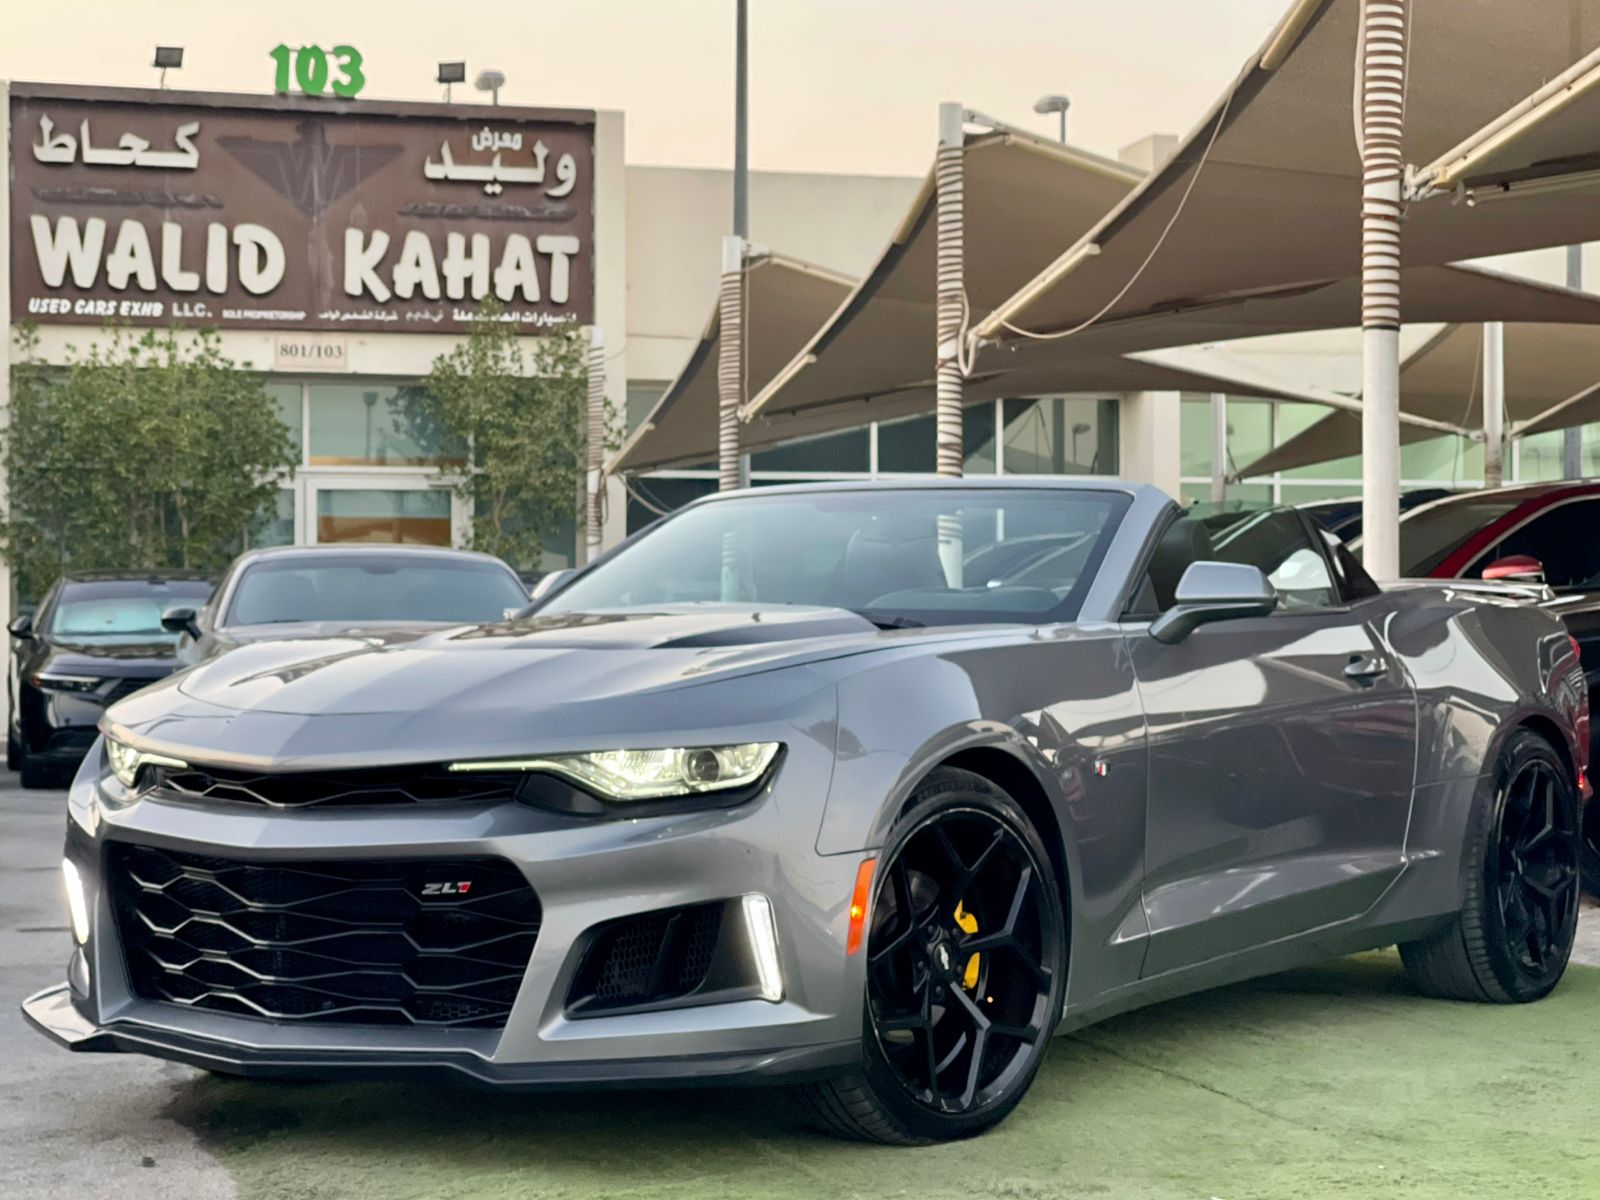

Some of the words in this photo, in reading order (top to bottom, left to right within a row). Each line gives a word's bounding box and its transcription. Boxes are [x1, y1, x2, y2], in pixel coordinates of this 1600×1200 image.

[270, 44, 365, 97] 103
[33, 113, 200, 169] كحاط
[472, 126, 522, 151] معرض
[424, 139, 577, 197] وليد
[30, 214, 286, 295] WALID
[344, 227, 580, 303] KAHAT
[28, 297, 72, 314] USED
[74, 299, 117, 316] CARS
[119, 301, 164, 317] EXHB
[280, 344, 342, 359] 801/103
[421, 881, 472, 895] ZL1
